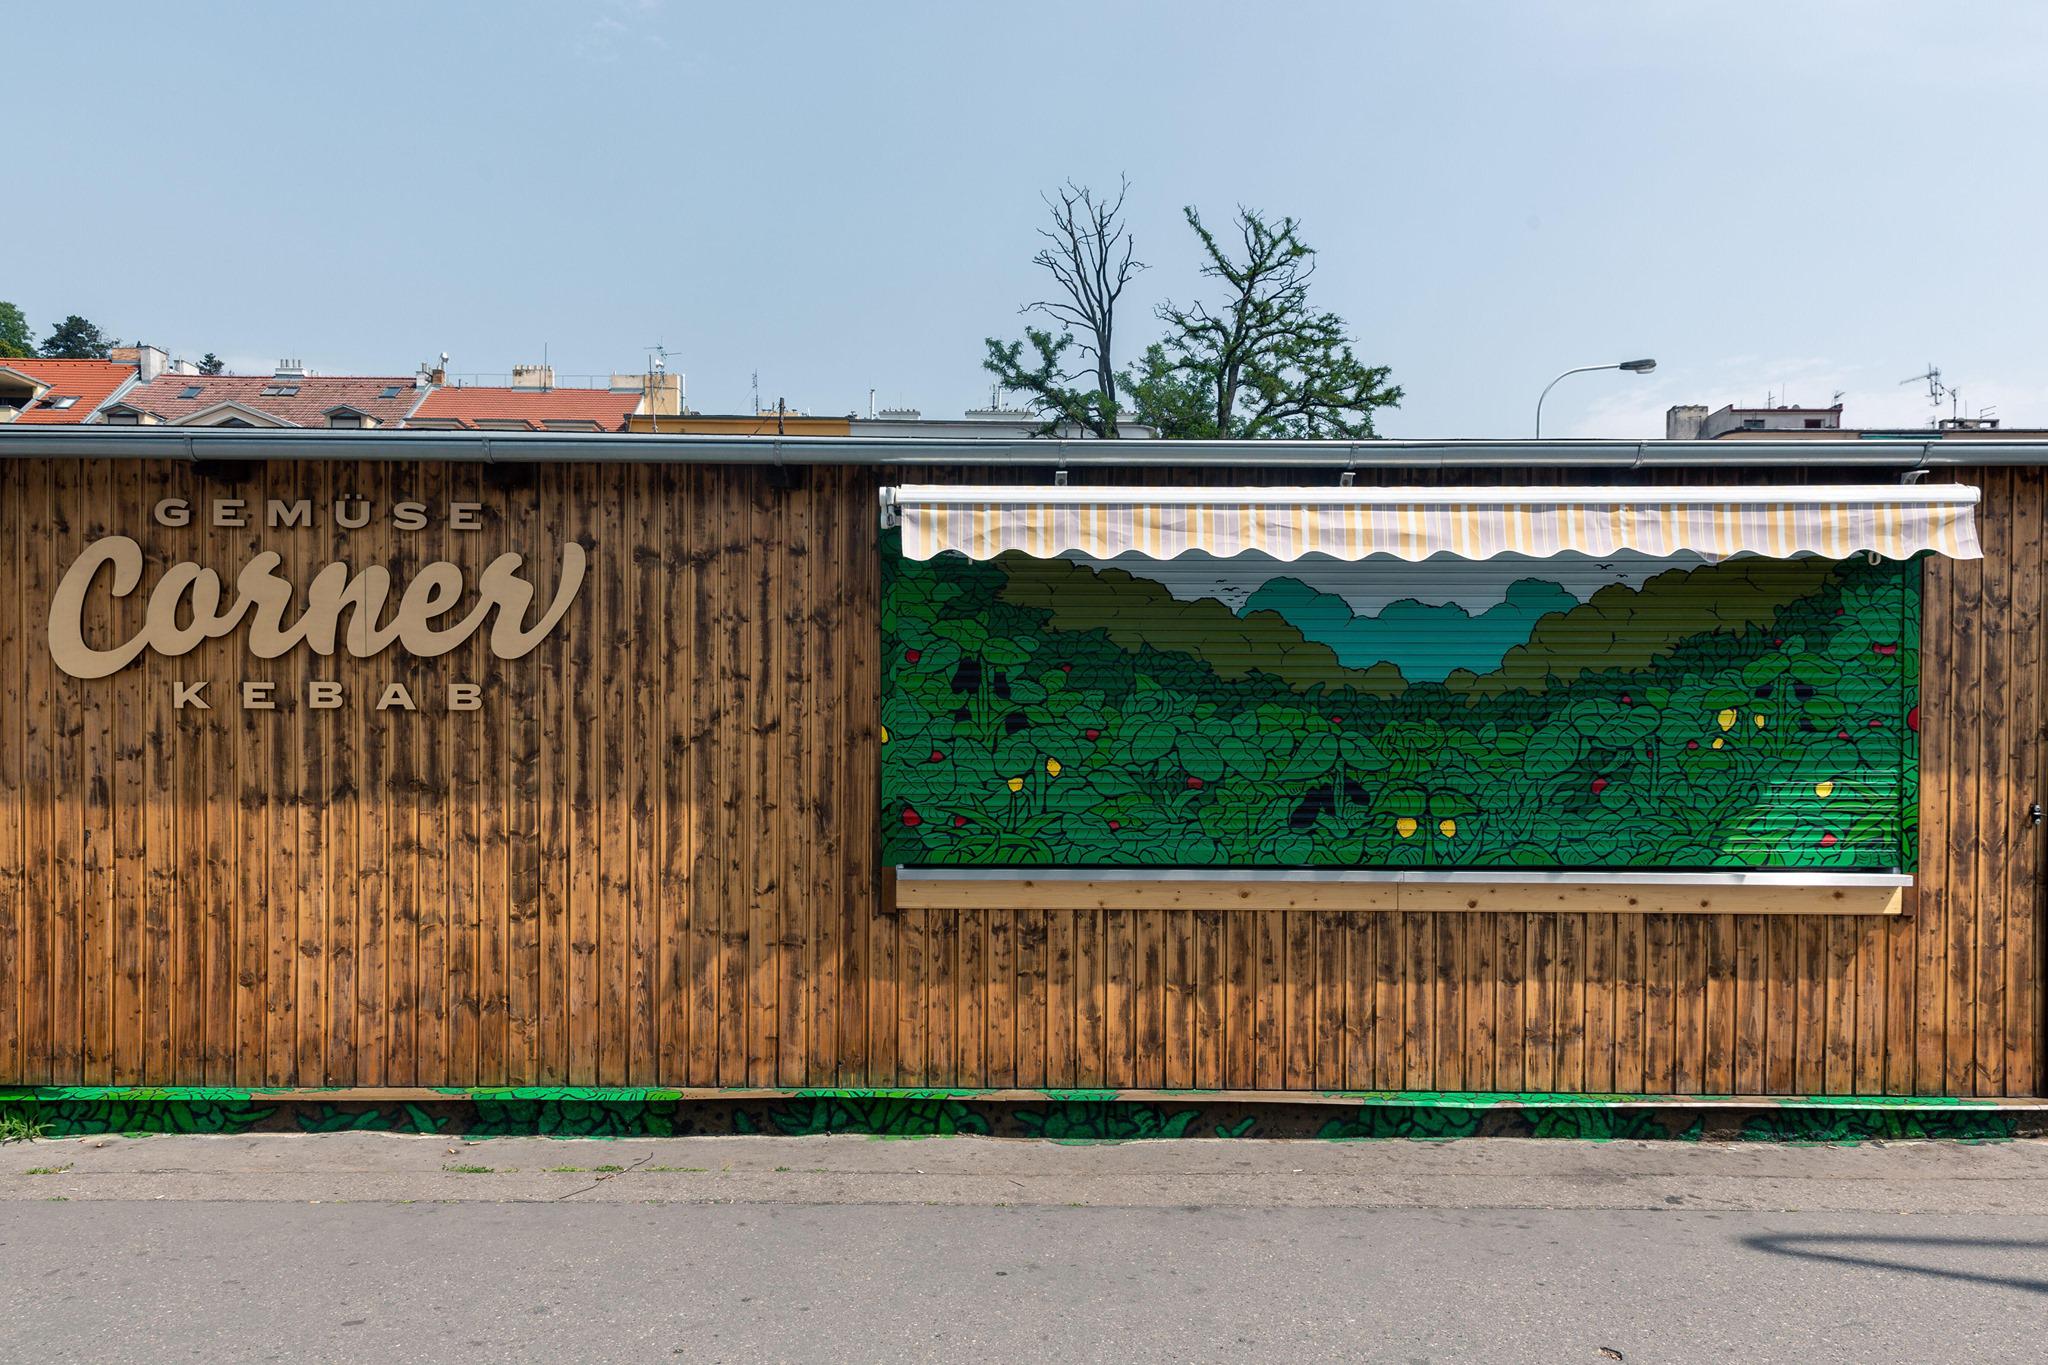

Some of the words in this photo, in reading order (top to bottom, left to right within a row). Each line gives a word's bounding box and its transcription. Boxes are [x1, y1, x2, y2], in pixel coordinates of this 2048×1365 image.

[154, 493, 484, 531] GEMÜSE
[48, 535, 587, 679] Corner
[172, 681, 484, 711] KEBAB
